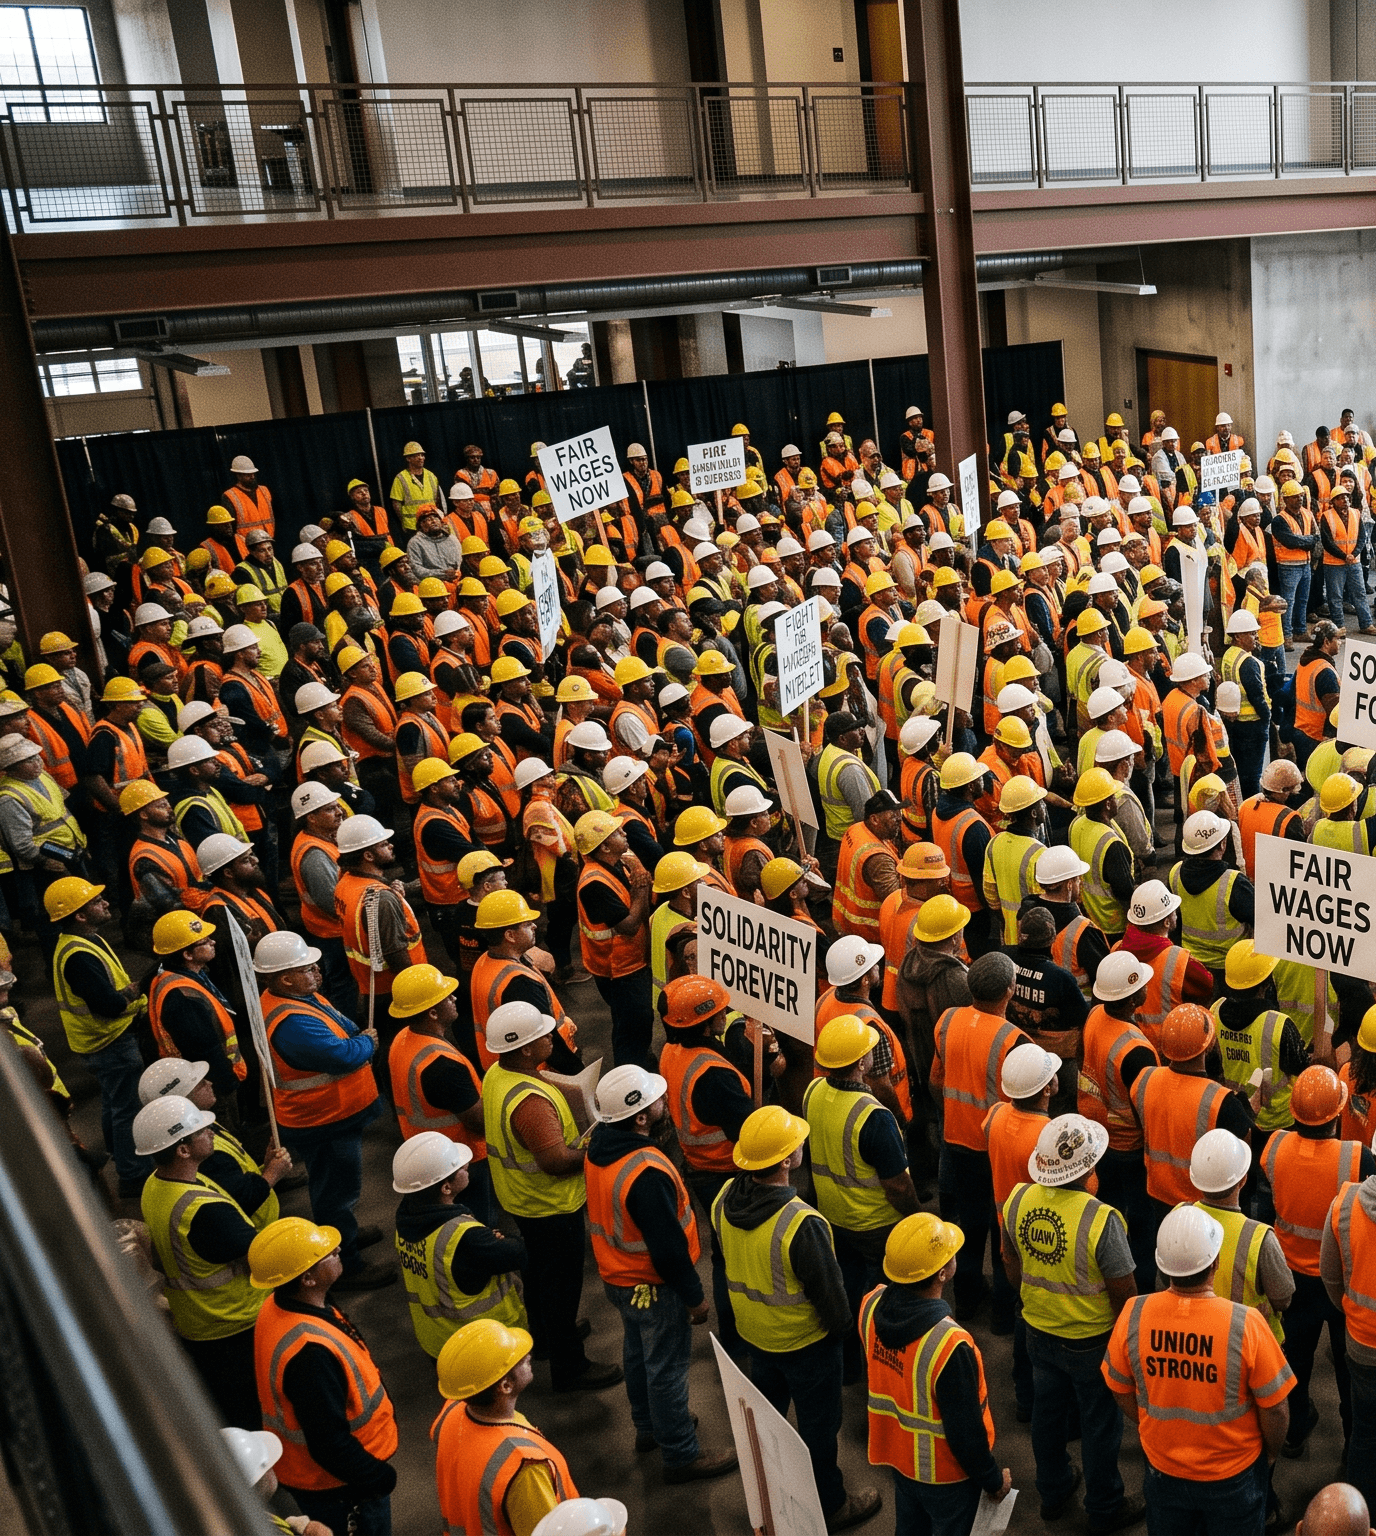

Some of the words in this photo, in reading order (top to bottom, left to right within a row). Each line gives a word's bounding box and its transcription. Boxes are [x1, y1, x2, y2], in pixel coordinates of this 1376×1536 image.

[555, 437, 598, 467] FAIR
[550, 455, 615, 492] WAGES
[568, 480, 610, 511] NOW
[1290, 849, 1351, 891] FAIR
[1269, 882, 1371, 933] WAGES
[701, 901, 811, 974] SOLIDARITY
[1286, 923, 1355, 967] NOW
[711, 948, 799, 1016] FOREVER
[1031, 1227, 1055, 1246] UAW
[1151, 1329, 1213, 1358] UNION
[1146, 1356, 1218, 1384] STRONG
